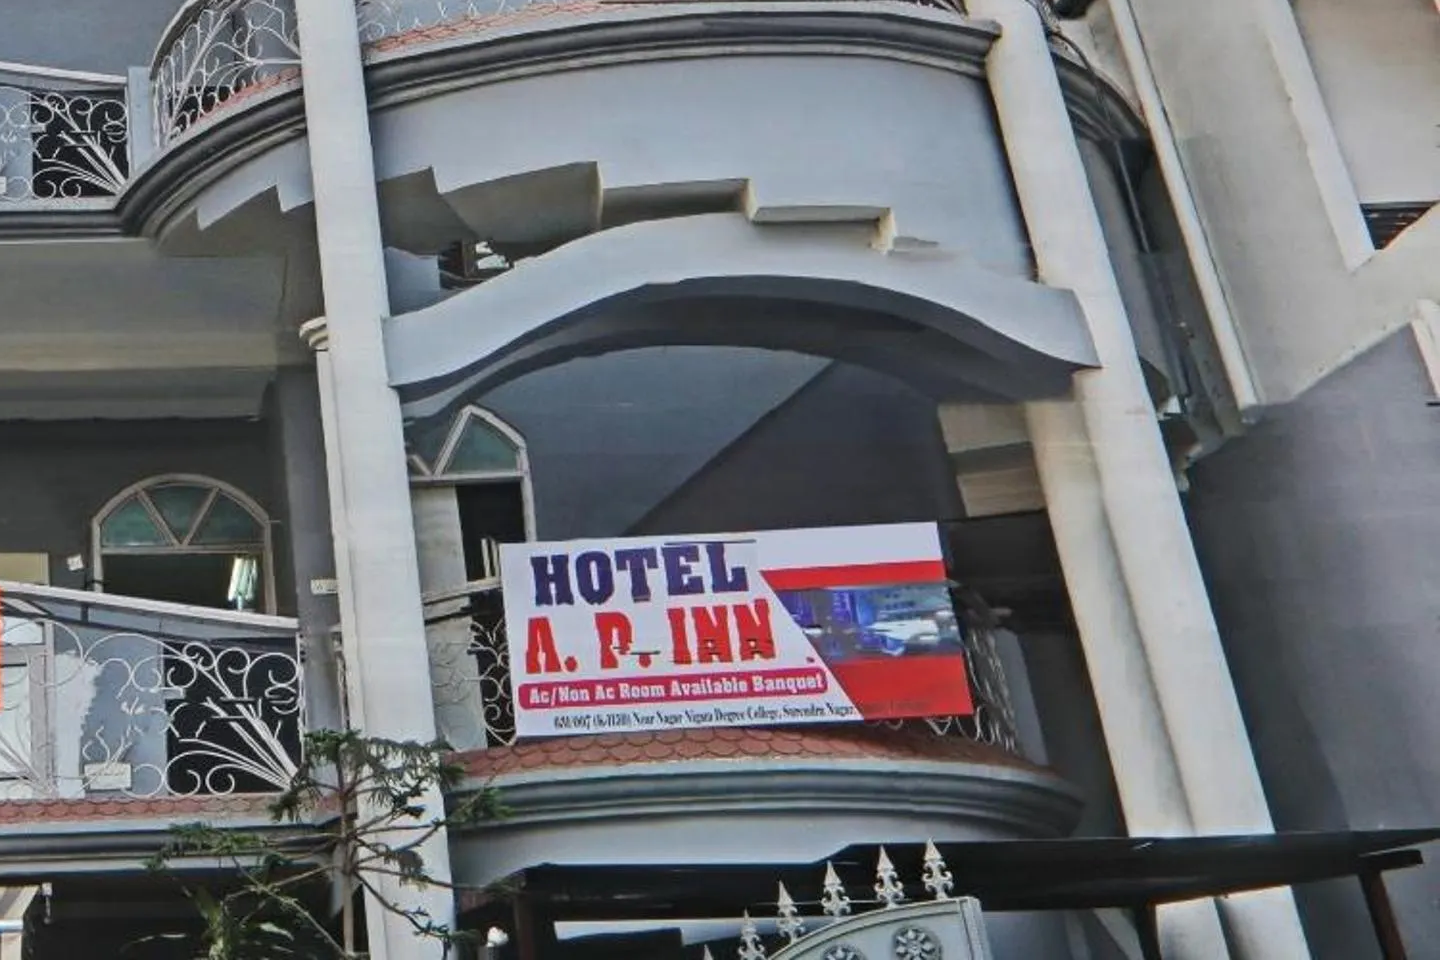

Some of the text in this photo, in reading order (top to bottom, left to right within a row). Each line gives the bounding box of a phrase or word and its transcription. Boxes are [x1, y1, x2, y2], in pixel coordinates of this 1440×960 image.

[530, 543, 749, 606] HOTEL
[667, 598, 776, 665] INN
[529, 673, 825, 706] Ac/Non Ac Room Available Banquet
